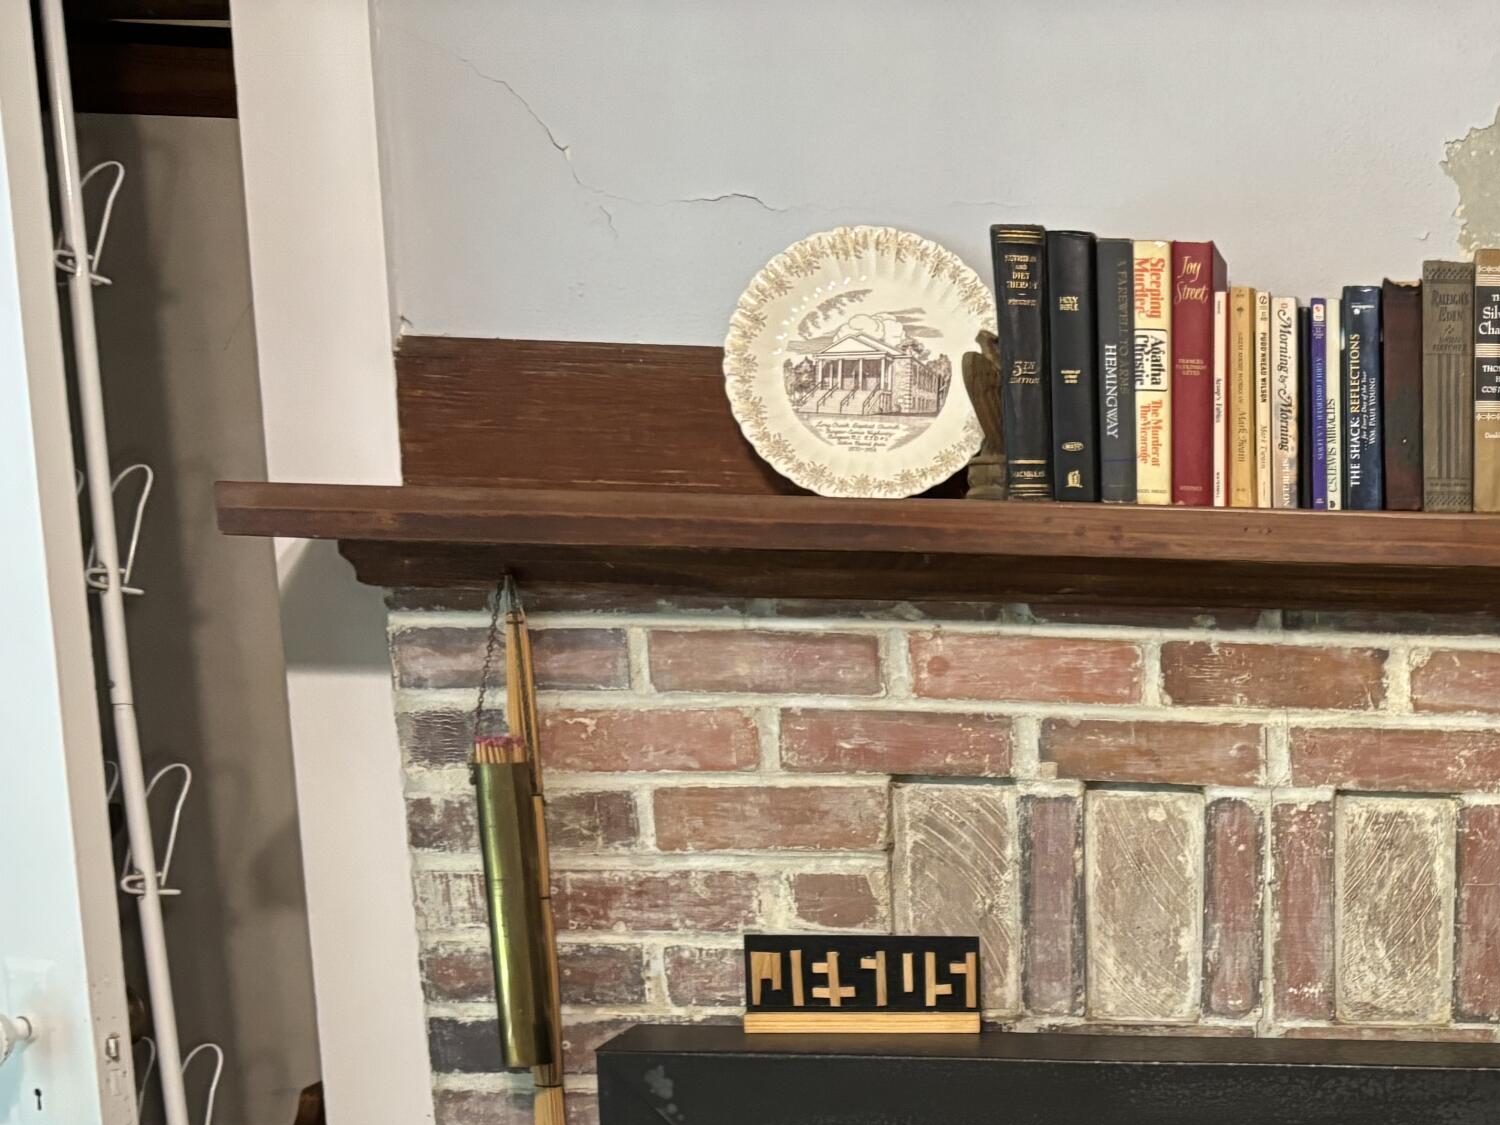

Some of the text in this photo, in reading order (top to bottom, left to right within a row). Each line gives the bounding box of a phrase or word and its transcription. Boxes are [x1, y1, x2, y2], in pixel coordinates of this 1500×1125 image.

[1012, 271, 1031, 280] DIET
[1135, 258, 1150, 313] Murder
[1146, 257, 1166, 319] Sleeping
[1175, 281, 1208, 304] Street
[1177, 256, 1202, 283] Joy
[1059, 296, 1079, 304] HOLY
[1135, 334, 1149, 386] Christie
[1150, 335, 1165, 386] Agatha
[1278, 310, 1293, 451] Morning by Morning
[1104, 344, 1119, 439] HEMINGWAY
[1151, 400, 1163, 417] The
[1349, 333, 1361, 487] THE SHACK: REFLECTIONS
[1368, 377, 1376, 406] YOUNG
[1326, 399, 1337, 444] MIRACLES
